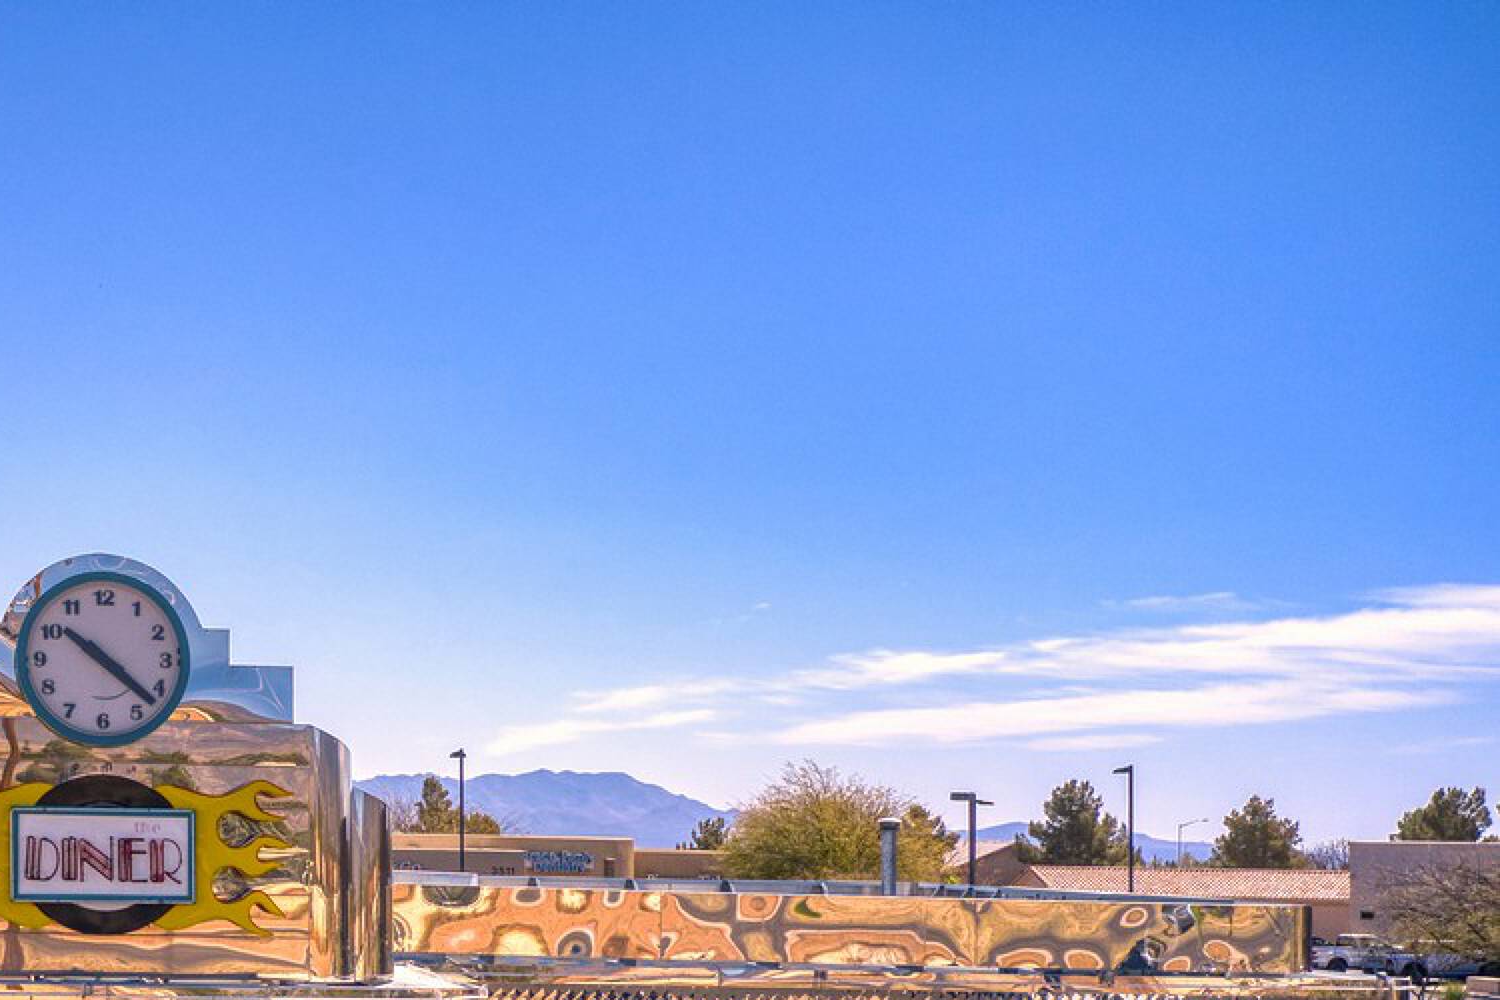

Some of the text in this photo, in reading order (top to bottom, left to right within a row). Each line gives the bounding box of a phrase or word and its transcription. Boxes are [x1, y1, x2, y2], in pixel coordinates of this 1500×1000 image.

[93, 589, 115, 606] 12
[63, 599, 81, 616] 11
[132, 601, 141, 617] 1
[41, 623, 62, 640] 10
[152, 624, 165, 640] 2
[34, 652, 47, 667] 9
[159, 652, 172, 669] 3
[41, 679, 55, 694] 8
[153, 679, 165, 697] 4
[63, 703, 76, 719] 7
[129, 705, 143, 721] 5
[97, 712, 110, 729] 6
[24, 835, 184, 885] DINER
